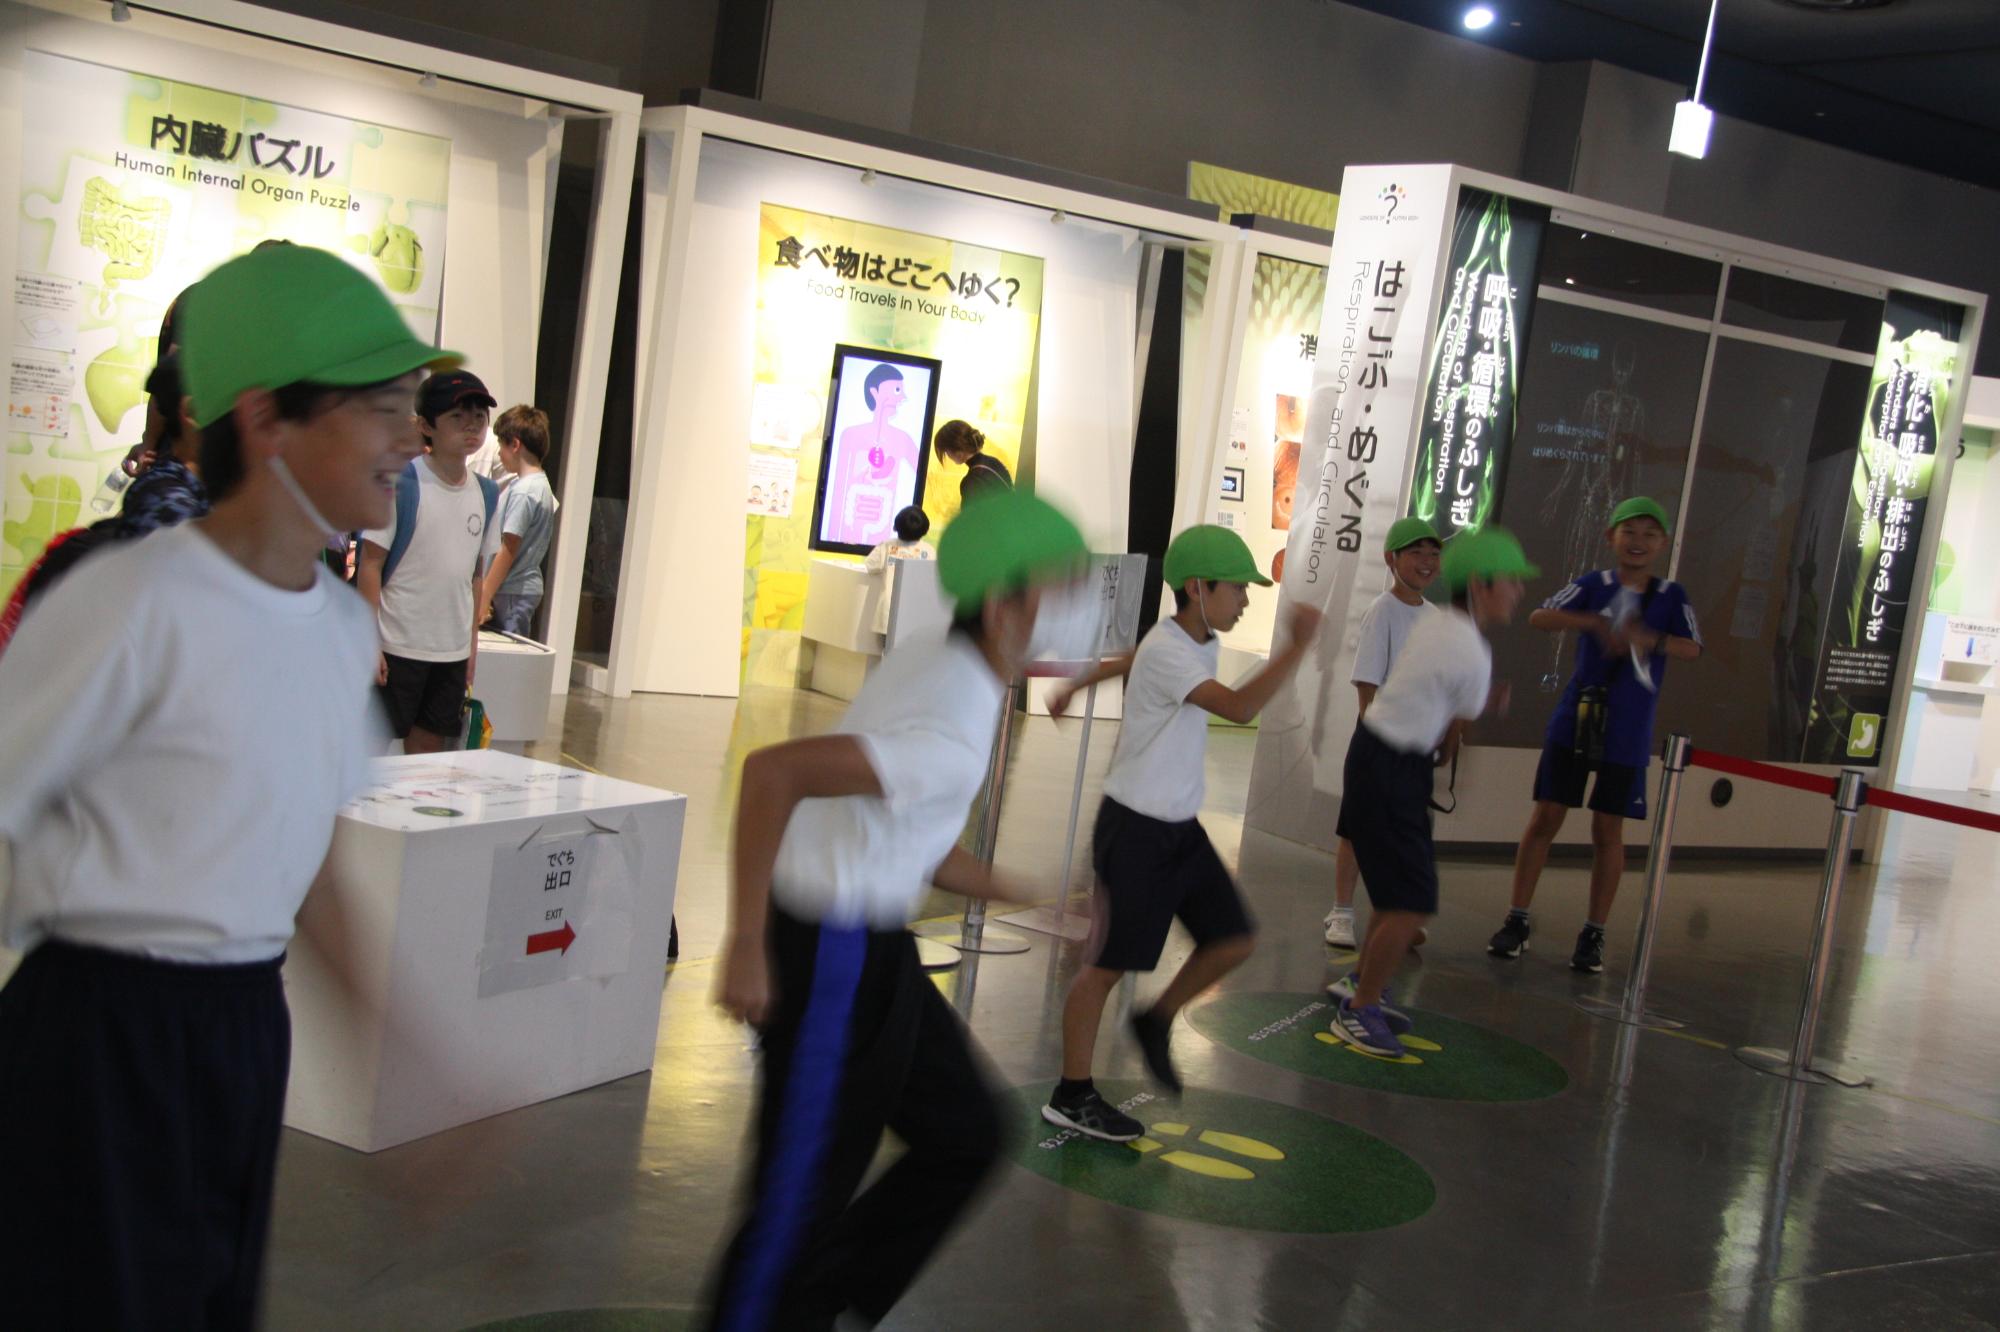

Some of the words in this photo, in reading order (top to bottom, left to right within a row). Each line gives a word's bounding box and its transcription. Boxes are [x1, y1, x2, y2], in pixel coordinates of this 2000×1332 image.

[150, 114, 336, 179] 内臓パズル
[114, 151, 176, 178] Human
[182, 164, 246, 191] Internal
[251, 179, 304, 202] Organ
[310, 189, 361, 212] Puzzle
[807, 279, 845, 300] Food
[850, 287, 897, 309] Travels
[917, 299, 947, 318] Your
[950, 305, 986, 325] Body
[1452, 267, 1467, 309] and
[1456, 271, 1480, 357] Wonders
[1335, 261, 1371, 394] Respiration
[1432, 313, 1459, 422] Circulation
[1452, 361, 1463, 383] of
[1327, 408, 1343, 451] and
[1434, 386, 1462, 494] Respiration
[1305, 461, 1339, 584] Circulation
[544, 870, 572, 892] 出口
[547, 849, 575, 867] でぐち
[544, 907, 564, 922] EXIT
